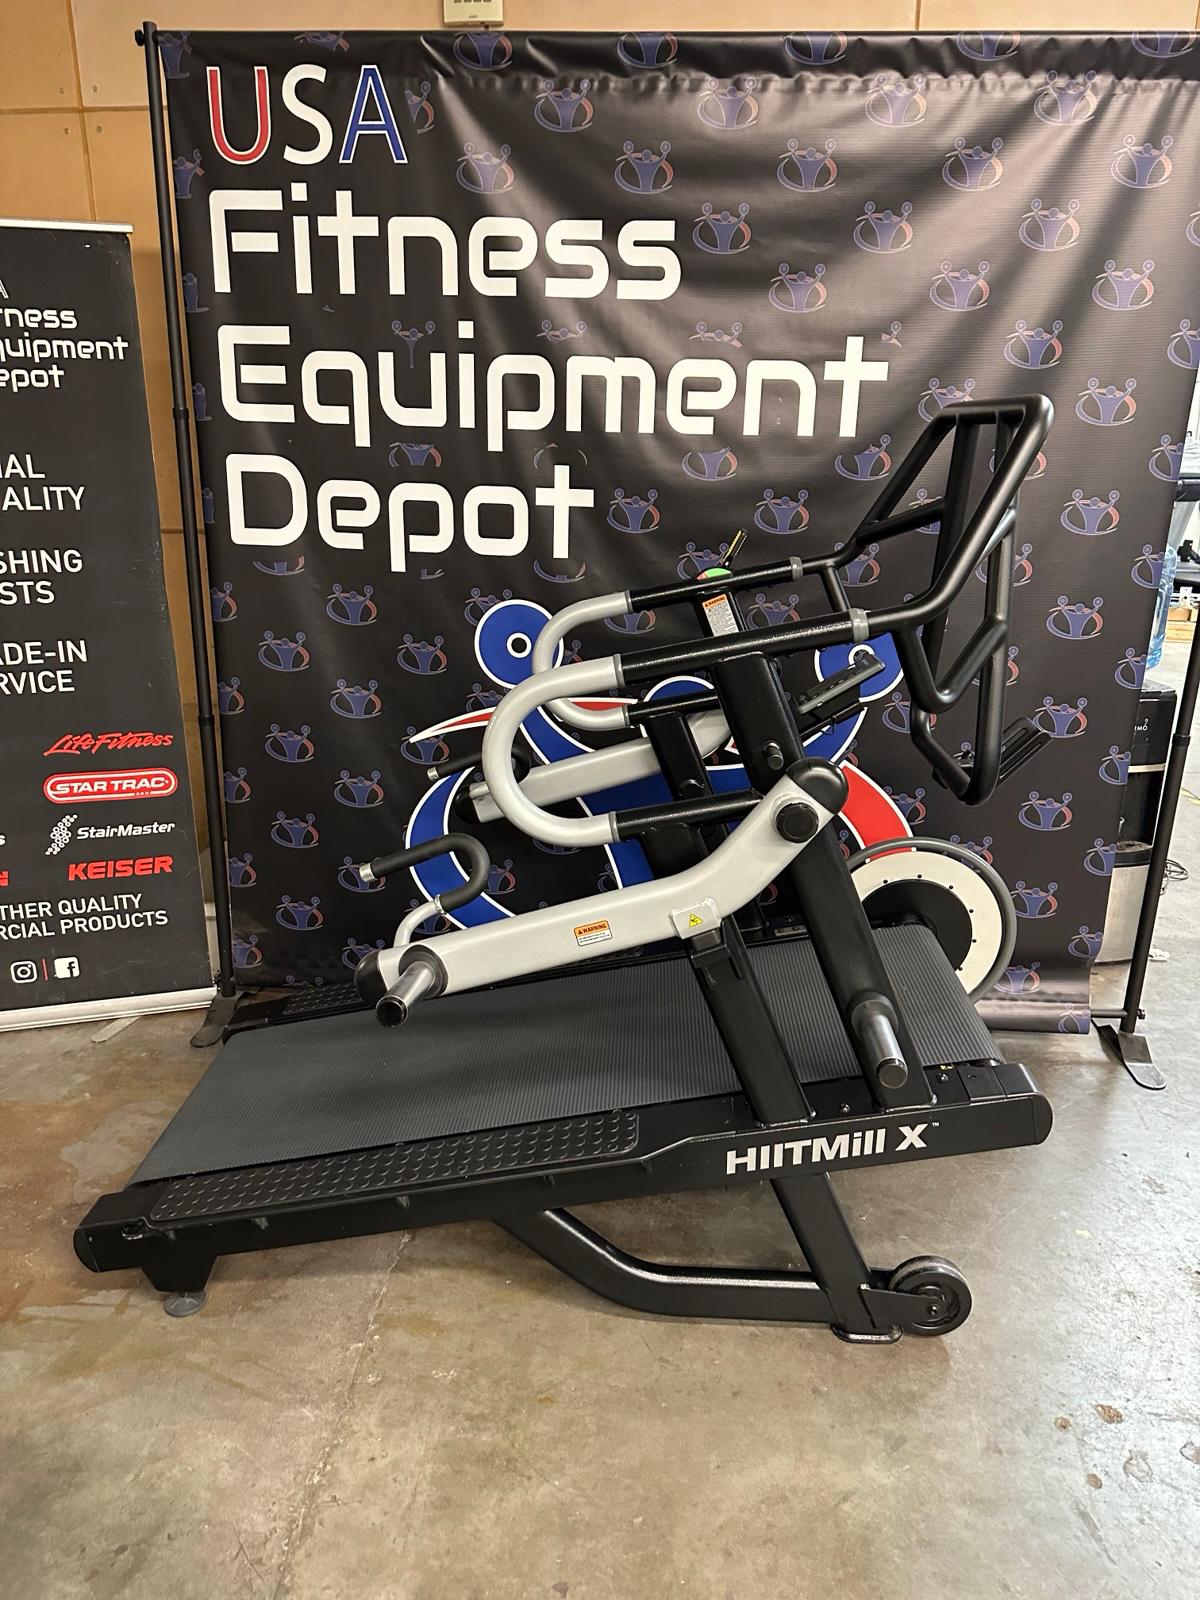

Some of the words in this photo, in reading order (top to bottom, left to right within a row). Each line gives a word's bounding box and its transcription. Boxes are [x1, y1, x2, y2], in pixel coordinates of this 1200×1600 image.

[206, 64, 408, 166] USA
[208, 181, 682, 301] Fitness
[0, 308, 78, 329] ness
[216, 320, 890, 453] Equipment
[0, 453, 46, 479] AL
[2, 486, 85, 511] ALITY
[225, 453, 596, 574] Depot
[0, 639, 88, 666] DE-IN
[43, 733, 95, 757] Life
[92, 732, 174, 754] Fitness
[54, 781, 107, 795] STAR
[110, 777, 167, 791] TRAC
[76, 822, 176, 840] StairMaster
[68, 855, 173, 881] KEISER
[58, 893, 142, 915] QUALITY
[60, 910, 169, 935] PRODUCTS
[726, 1128, 887, 1175] HIITMill
[895, 1123, 929, 1151] X
